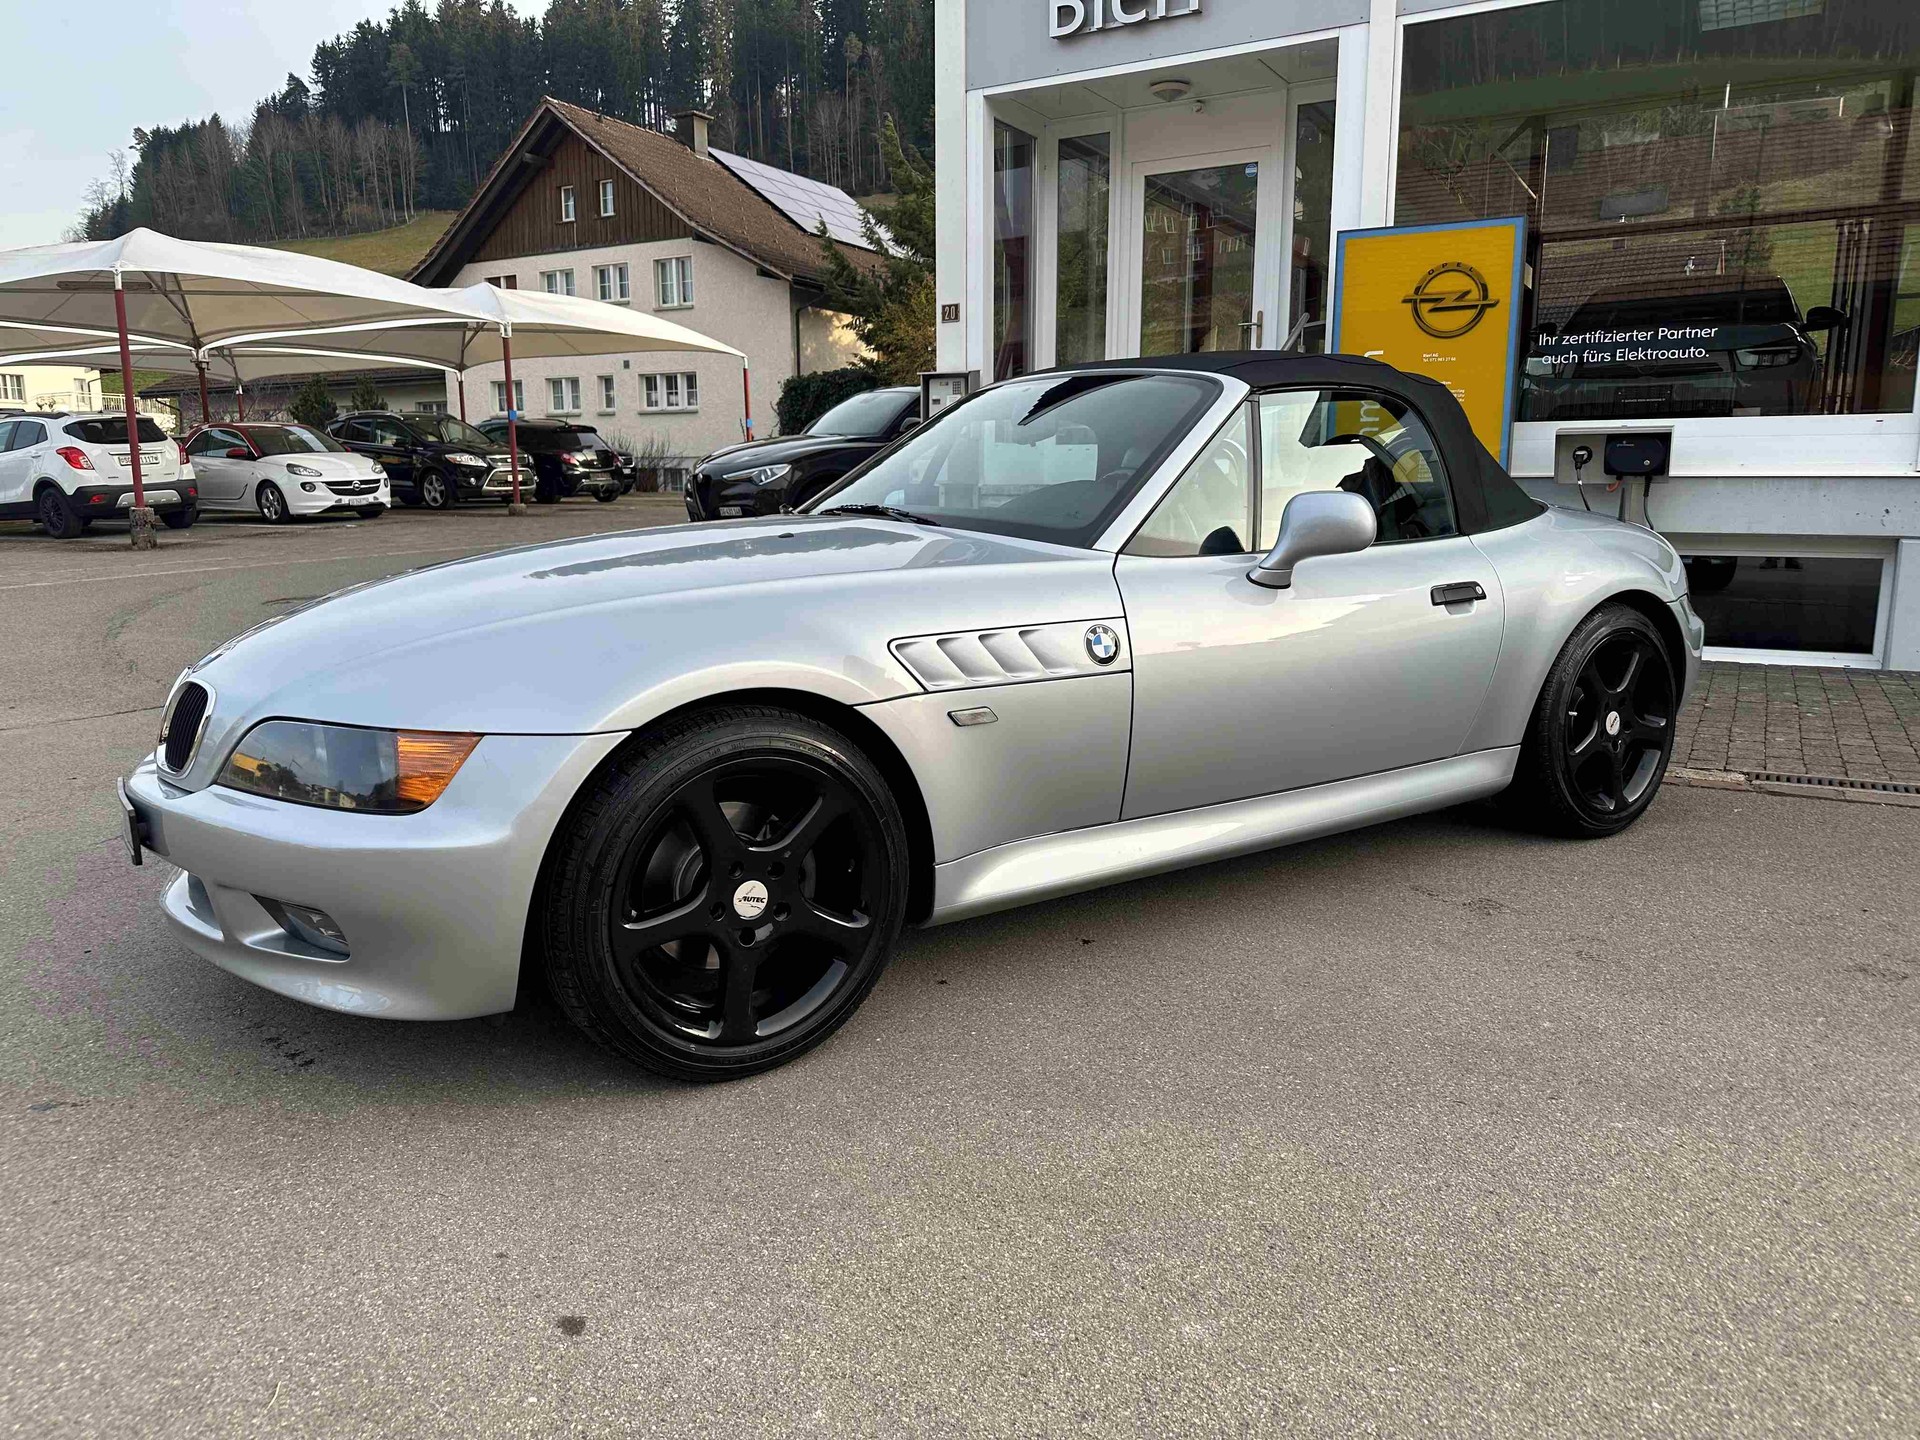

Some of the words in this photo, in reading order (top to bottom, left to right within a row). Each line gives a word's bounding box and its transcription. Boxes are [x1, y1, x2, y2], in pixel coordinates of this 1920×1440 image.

[1427, 262, 1474, 276] OPEL
[944, 305, 956, 320] 20
[1538, 333, 1558, 346] Ihr
[1561, 330, 1654, 345] zertifizierter
[1657, 327, 1718, 340] Partner
[1541, 350, 1578, 365] auch
[1583, 349, 1611, 363] fürs
[1615, 345, 1709, 362] Elektroauto.
[1087, 626, 1115, 641] BMW
[741, 896, 766, 904] AUTEC
